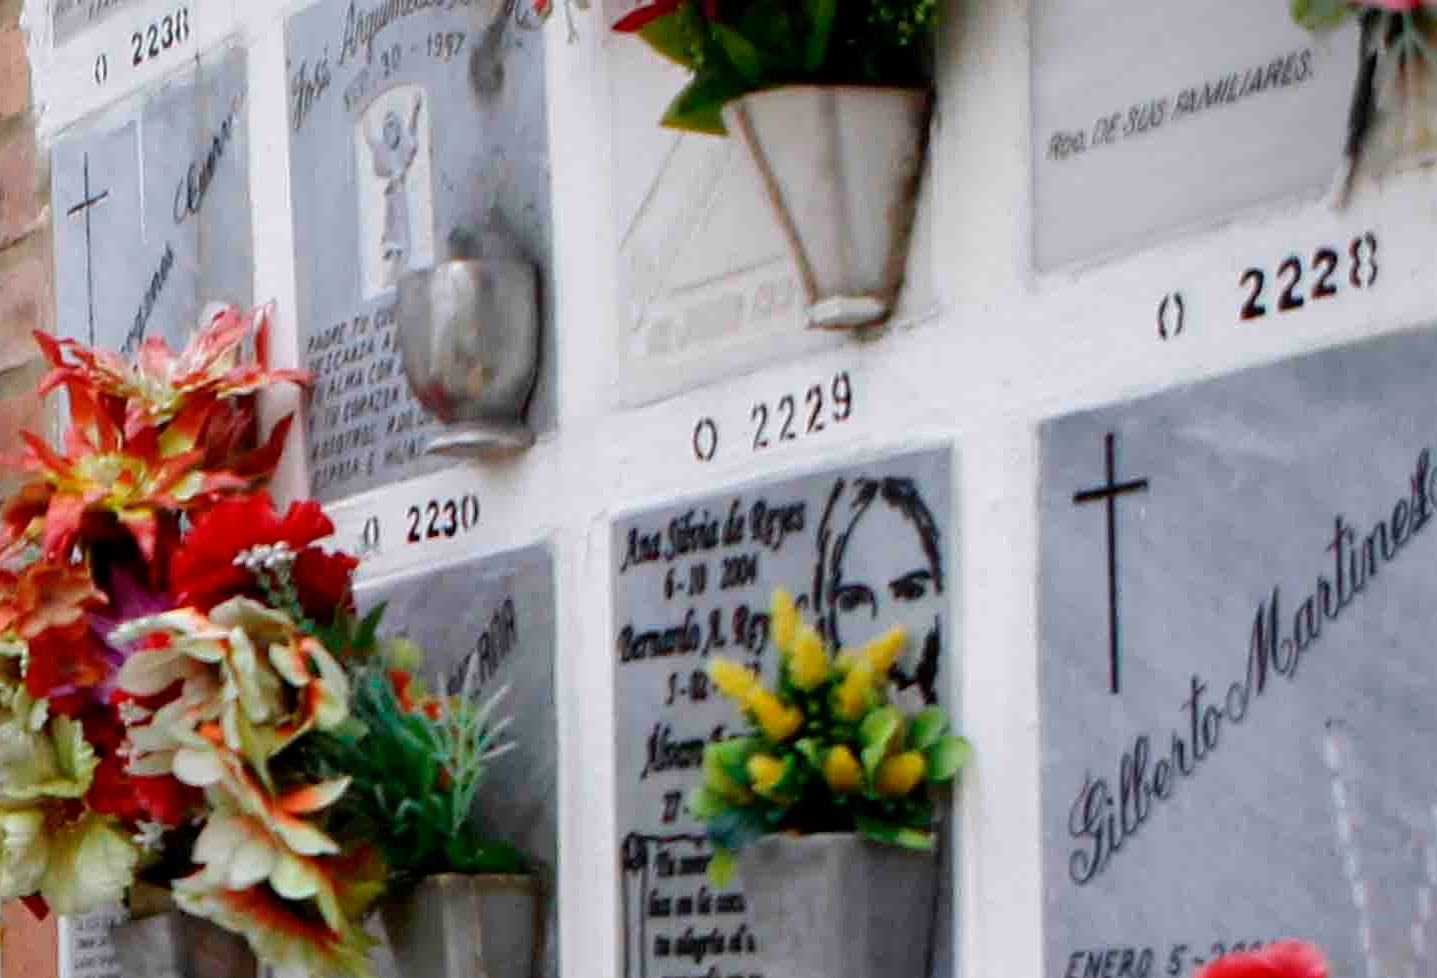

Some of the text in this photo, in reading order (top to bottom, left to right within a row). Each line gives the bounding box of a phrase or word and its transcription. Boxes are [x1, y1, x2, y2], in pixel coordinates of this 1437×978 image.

[1123, 97, 1167, 138] SUS
[1237, 230, 1379, 323] 2228
[750, 371, 853, 452] 2229
[406, 493, 480, 544] 2230
